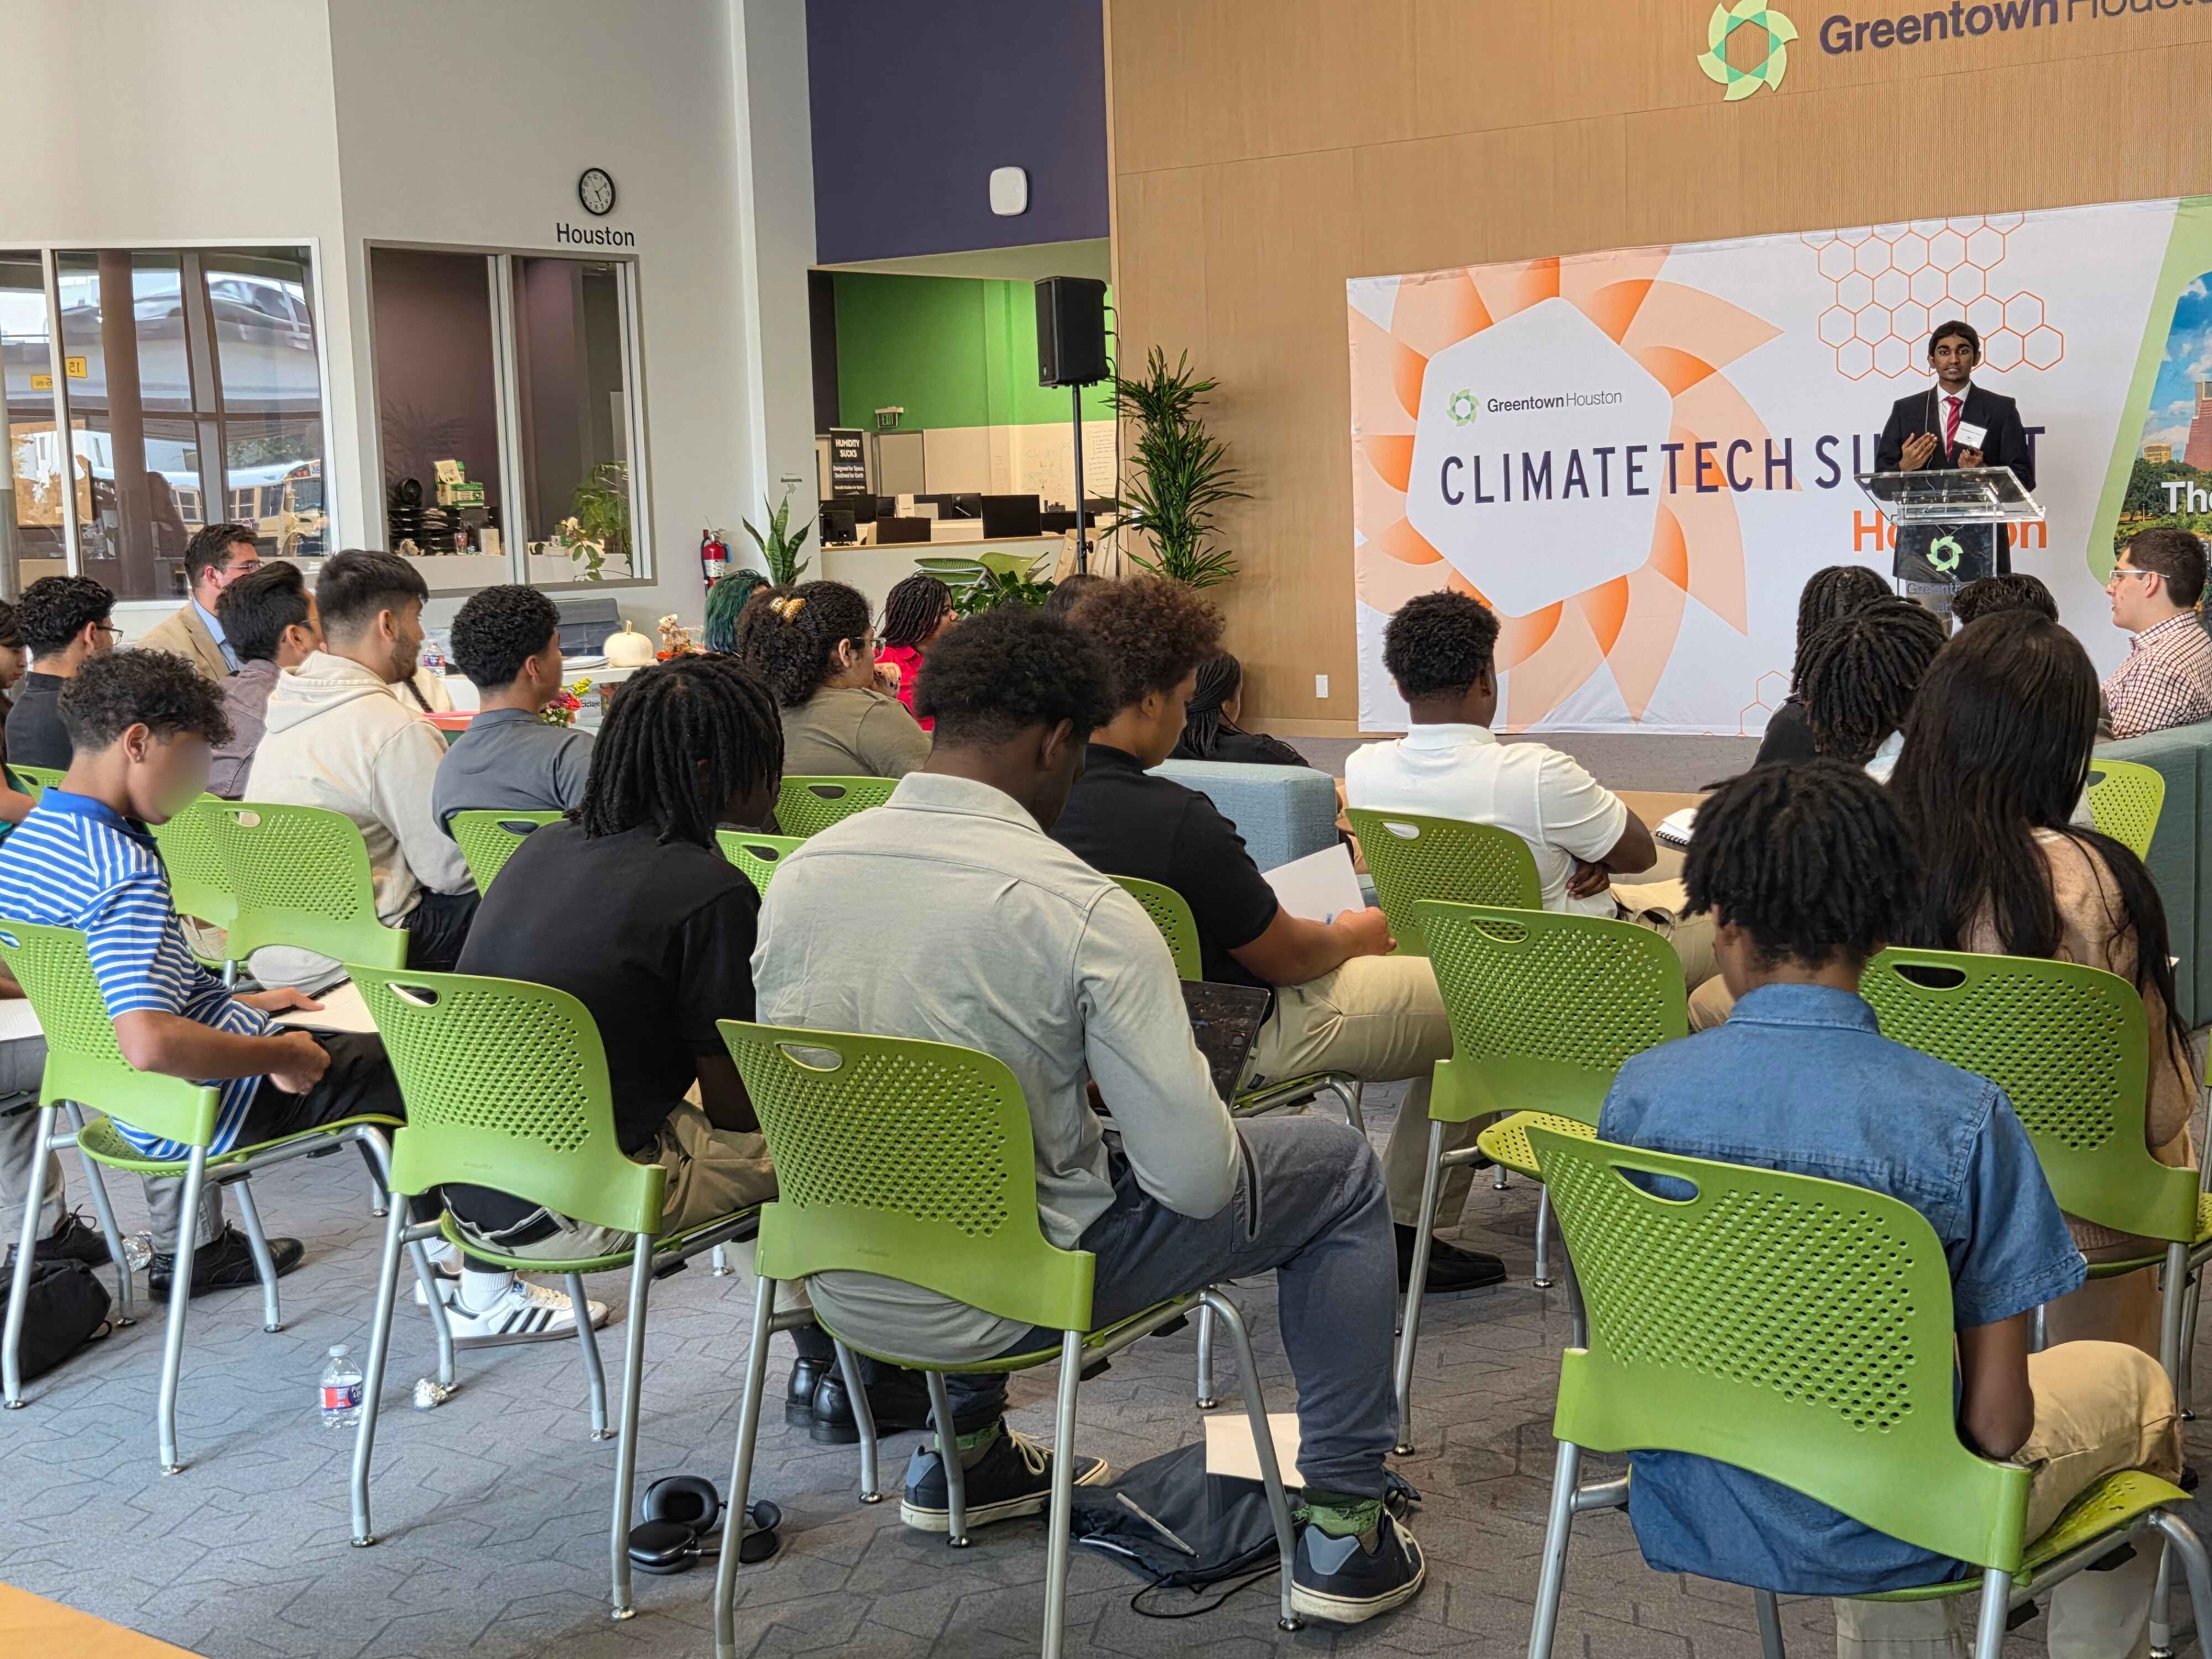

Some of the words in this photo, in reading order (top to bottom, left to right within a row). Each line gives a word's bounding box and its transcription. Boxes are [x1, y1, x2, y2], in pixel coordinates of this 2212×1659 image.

[556, 222, 635, 246] Houston
[1487, 396, 1564, 412] Greentown
[1567, 391, 1622, 406] Houston
[836, 439, 860, 447] HUMIDITY
[1814, 426, 2046, 490] SUT
[2161, 481, 2212, 513] Th
